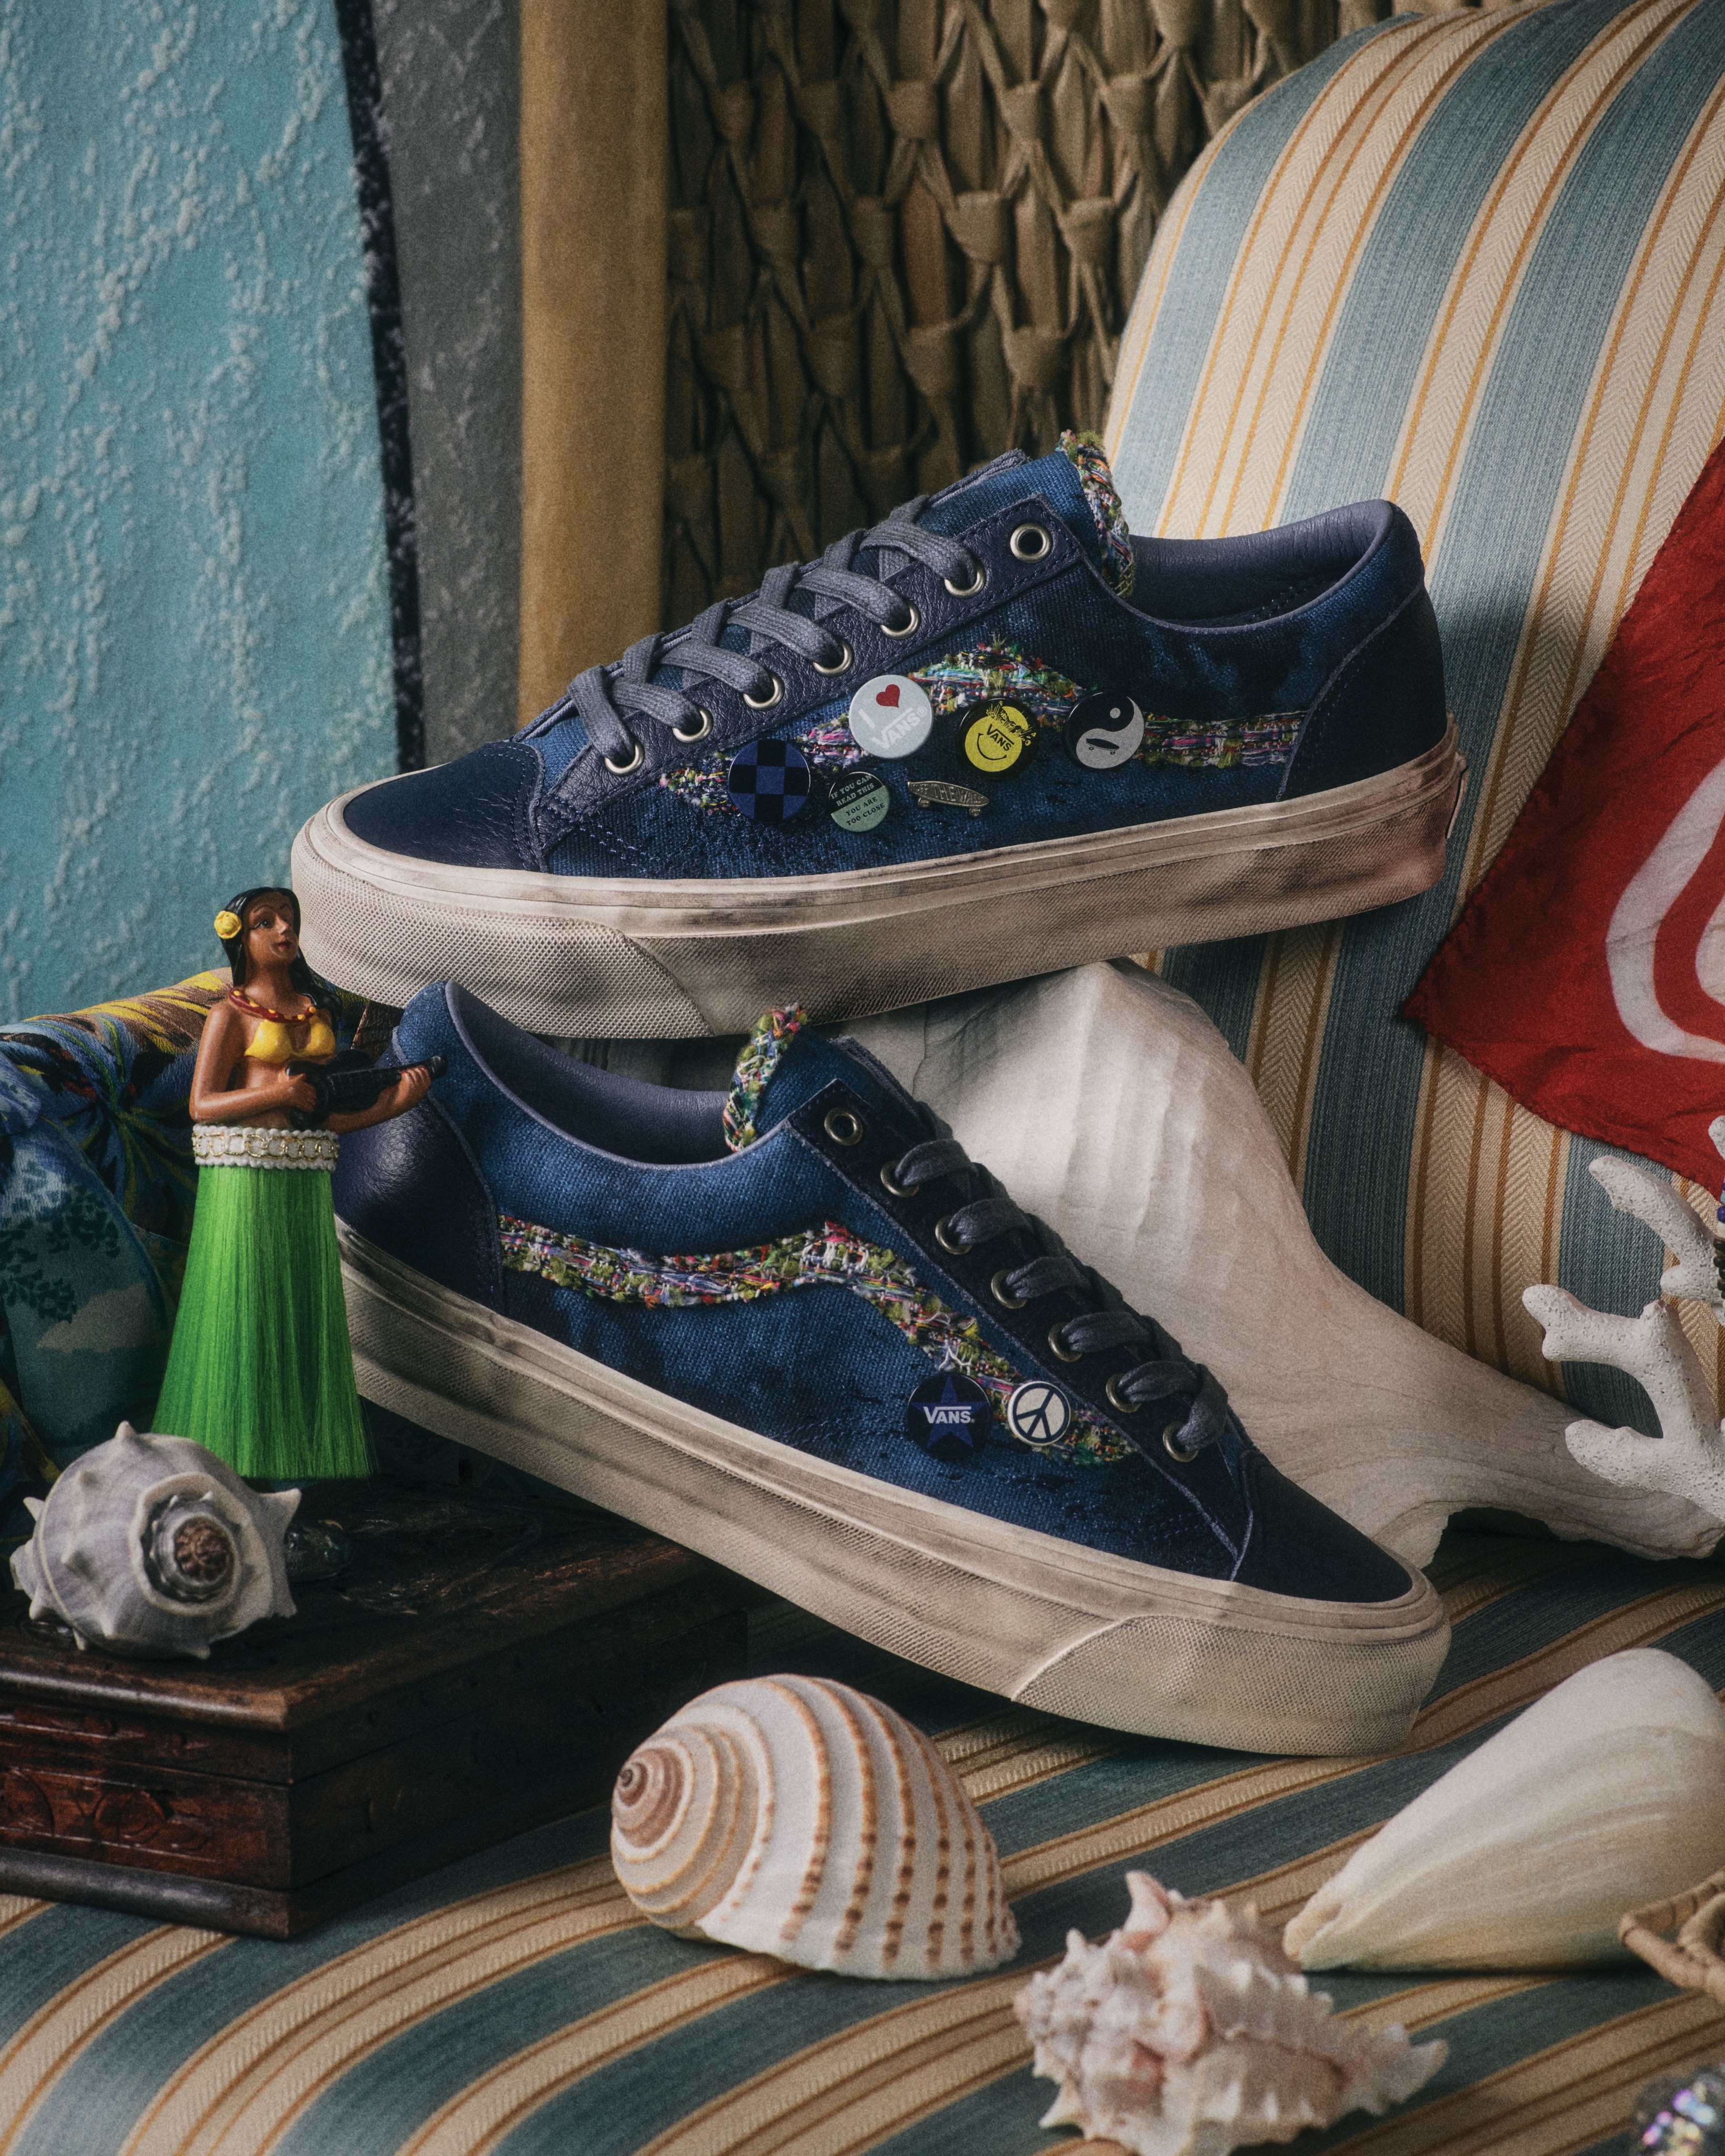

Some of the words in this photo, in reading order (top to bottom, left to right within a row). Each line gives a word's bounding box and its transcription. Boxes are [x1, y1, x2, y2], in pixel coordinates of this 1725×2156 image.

[858, 708, 876, 729] I
[986, 723, 1015, 751] VANS
[836, 792, 856, 806] READ
[857, 783, 874, 795] THIS
[839, 783, 855, 794] YOU
[856, 775, 872, 785] CAN
[931, 784, 956, 801] THE
[845, 805, 861, 816] YOU
[863, 796, 878, 807] ARE
[846, 815, 861, 826] TOO
[863, 803, 885, 817] CLOSE
